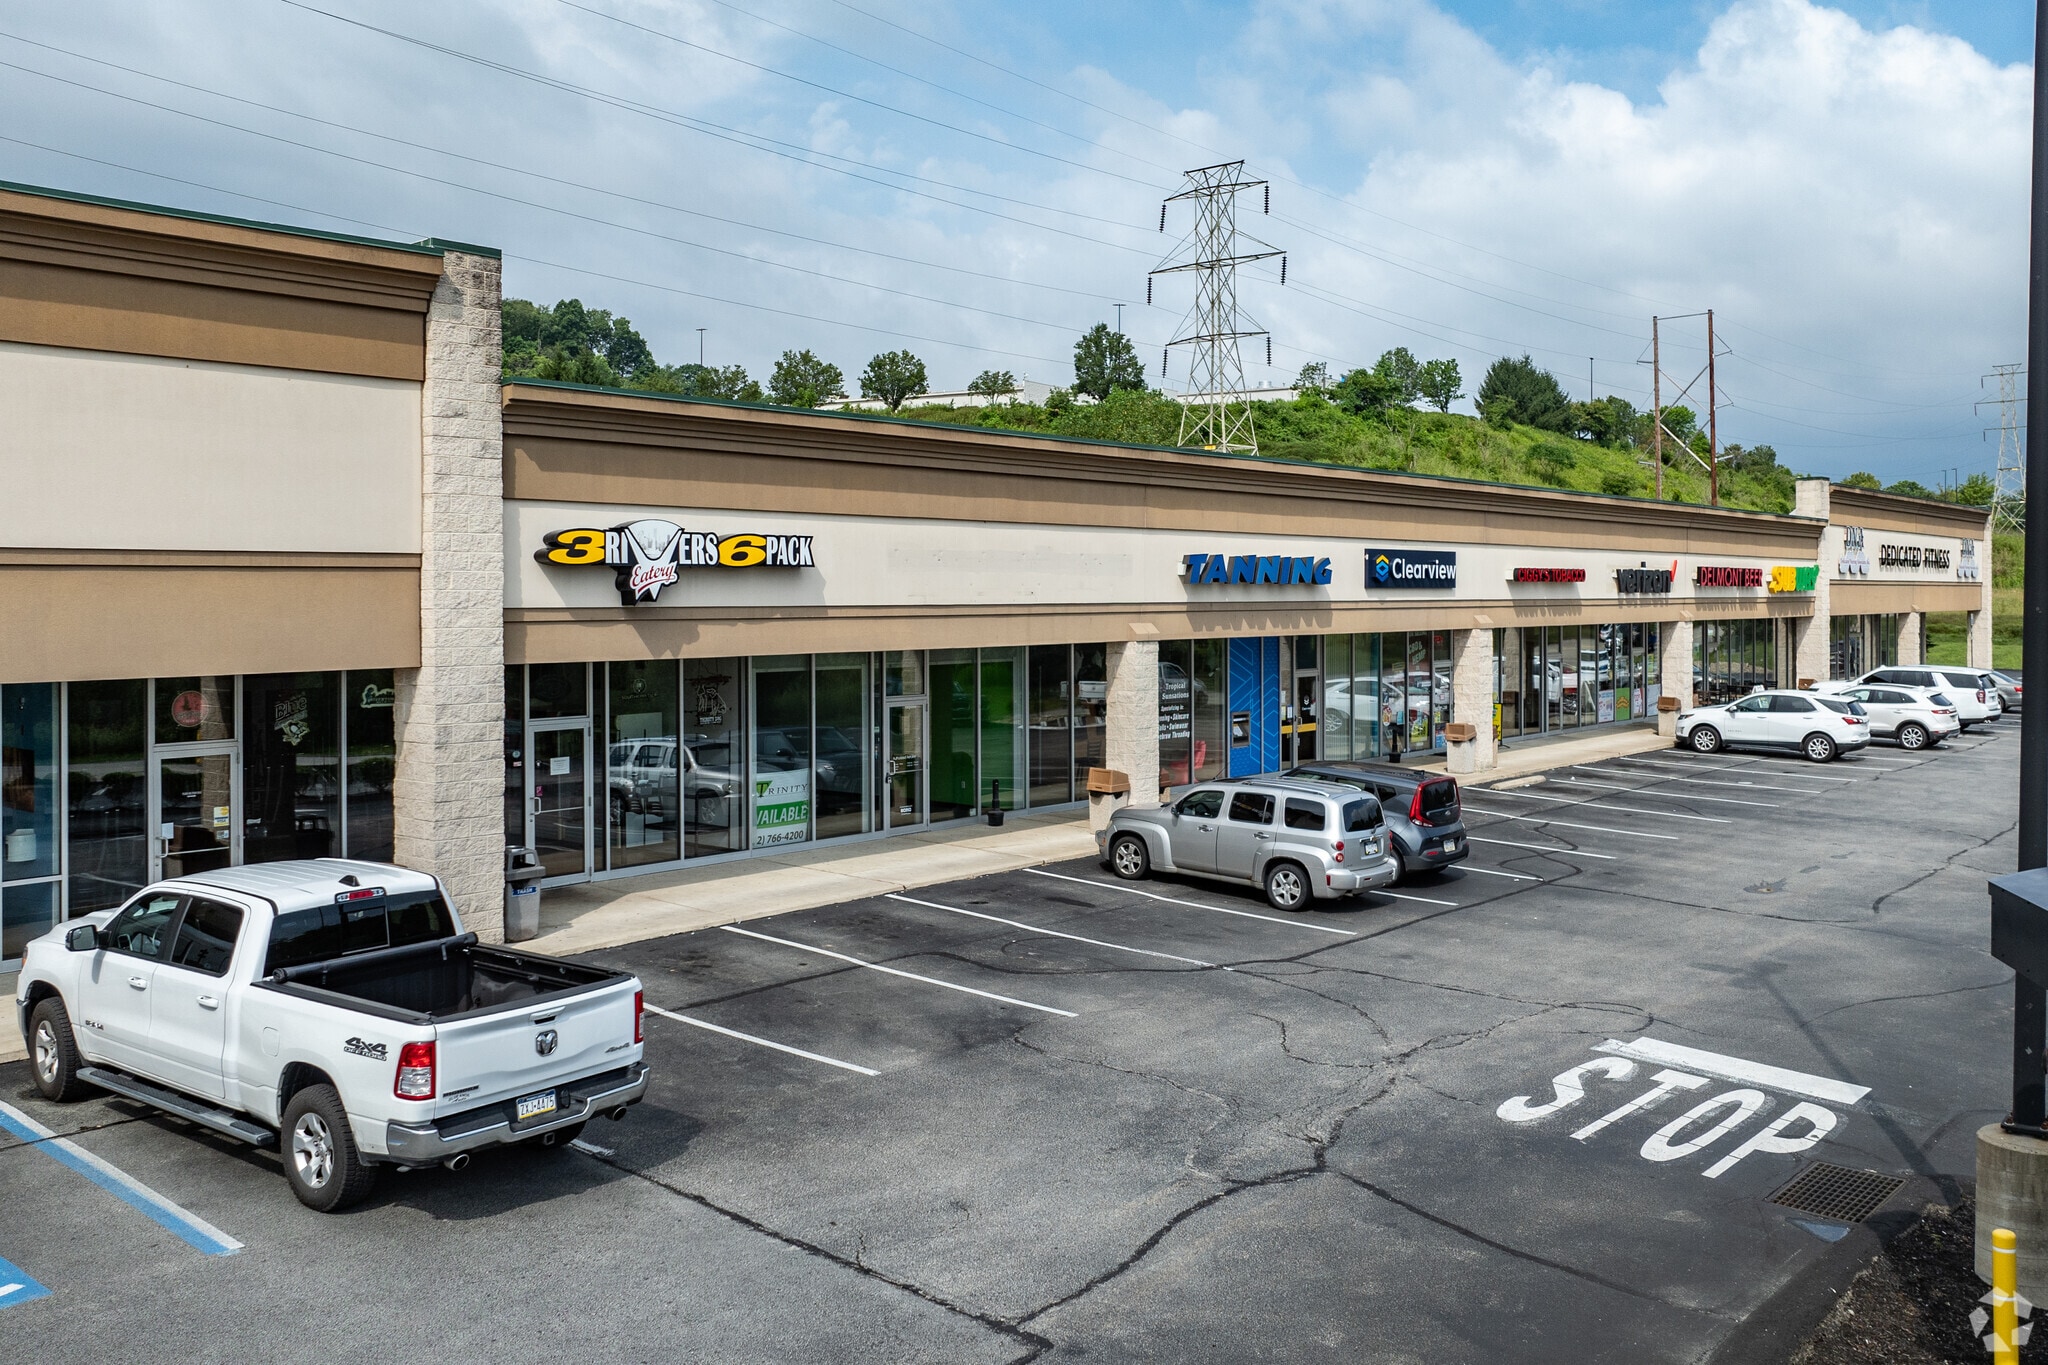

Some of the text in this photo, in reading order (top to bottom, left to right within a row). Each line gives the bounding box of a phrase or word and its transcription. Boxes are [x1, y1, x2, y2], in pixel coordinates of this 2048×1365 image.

[548, 530, 605, 565] 3
[718, 535, 767, 567] 6
[766, 535, 815, 567] PACK
[1880, 544, 1950, 569] DEDICATED FITNESS
[631, 563, 677, 588] Eatery
[1186, 553, 1332, 585] TANNING
[1391, 558, 1457, 580] Clearview
[1518, 567, 1586, 582] CIGGY'S TOBACCO
[1616, 561, 1671, 593] verizon
[1701, 566, 1763, 587] DELMONT BEER
[1165, 682, 1186, 690] Tropical
[766, 830, 804, 844] 766-4200
[1496, 1056, 1838, 1179] STOP
